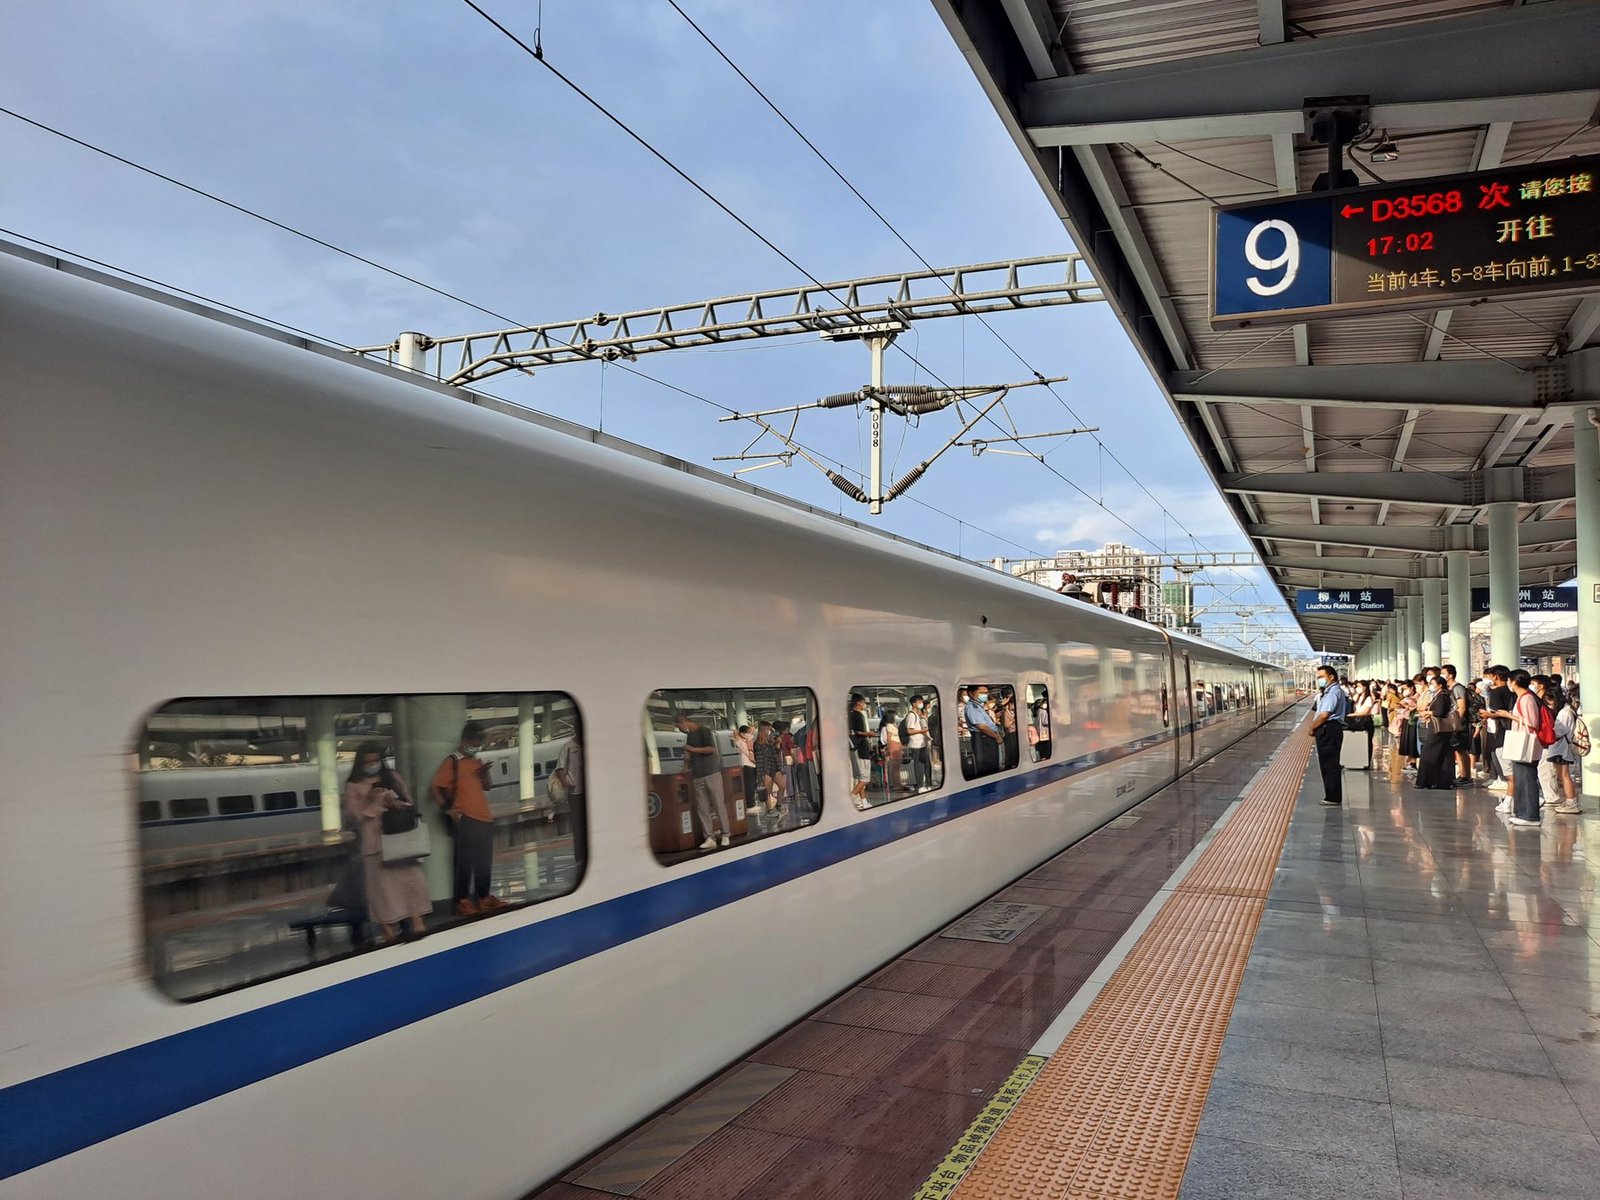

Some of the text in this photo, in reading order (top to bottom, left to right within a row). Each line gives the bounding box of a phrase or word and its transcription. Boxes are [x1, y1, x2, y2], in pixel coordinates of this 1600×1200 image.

[1518, 173, 1592, 200] 请您按
[1372, 182, 1511, 222] D3568 次
[1496, 215, 1553, 243] 开往
[1367, 231, 1434, 256] 17:02
[1245, 219, 1300, 296] 9
[1317, 591, 1372, 602] 柳州站
[1333, 602, 1359, 611] Railway
[1519, 589, 1555, 600] 州站
[1519, 602, 1541, 610] ailway
